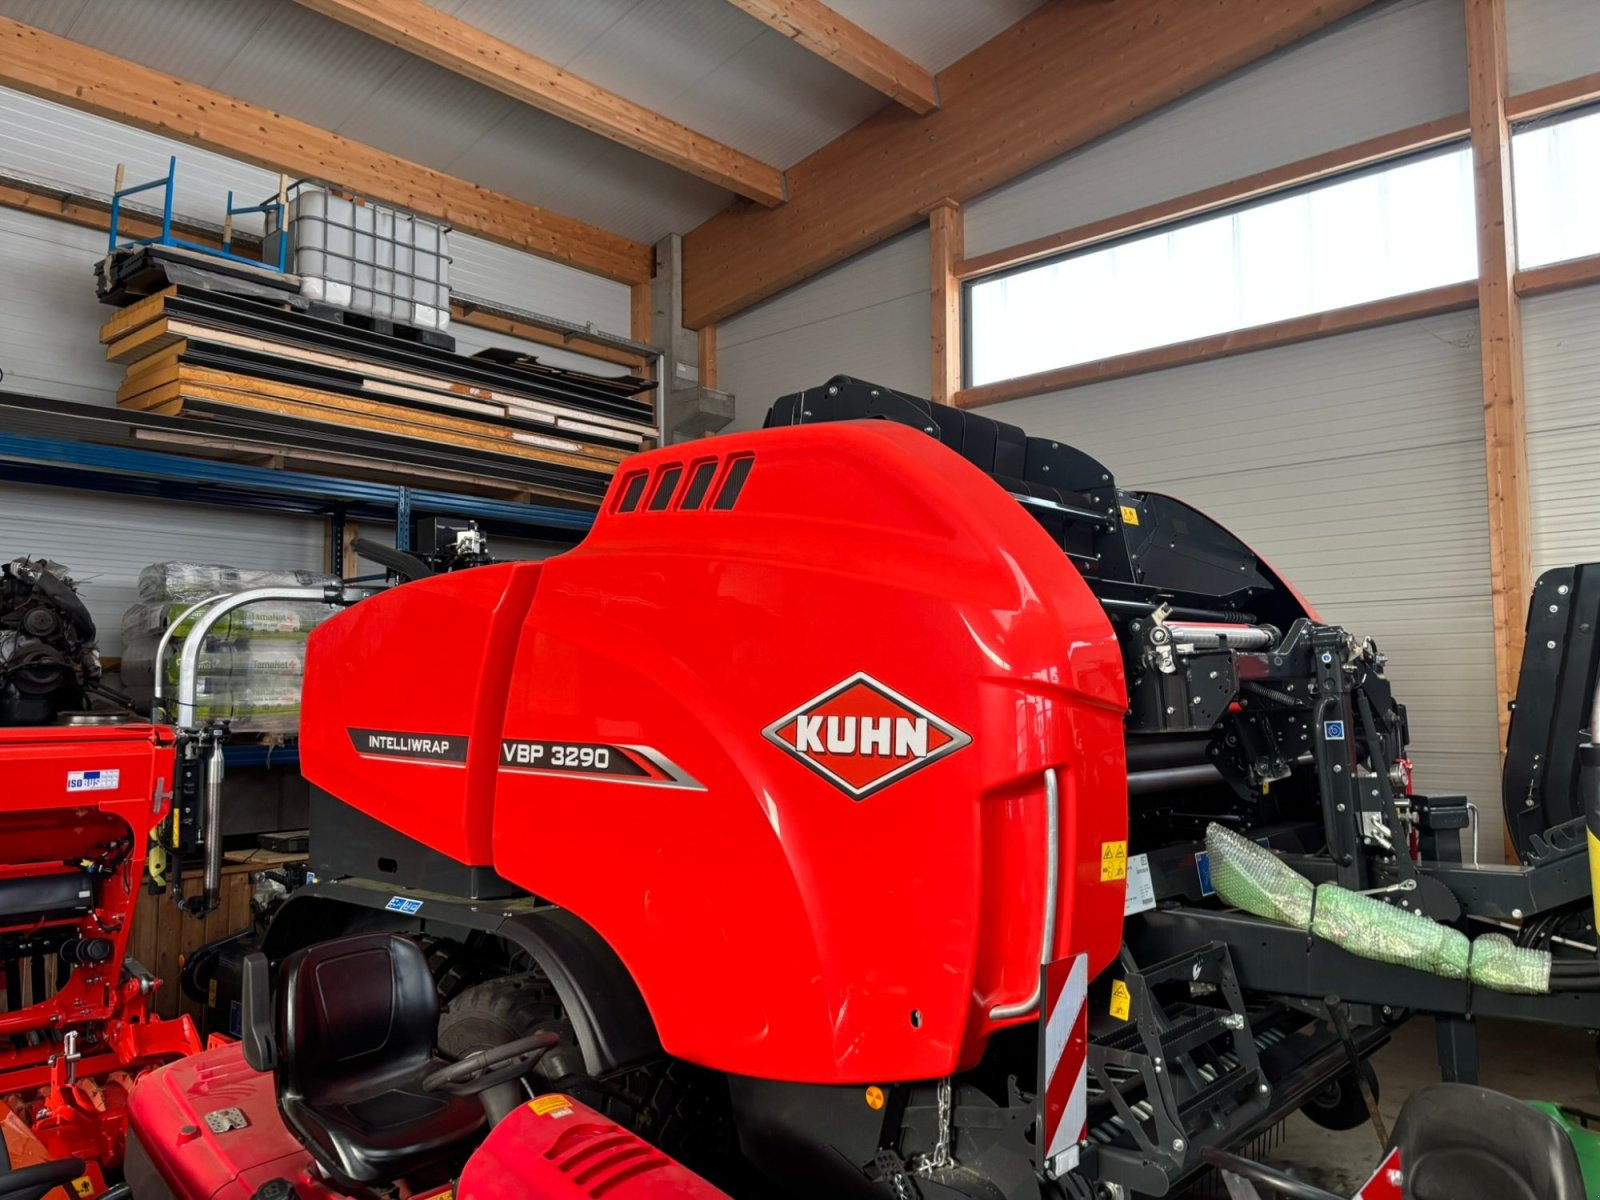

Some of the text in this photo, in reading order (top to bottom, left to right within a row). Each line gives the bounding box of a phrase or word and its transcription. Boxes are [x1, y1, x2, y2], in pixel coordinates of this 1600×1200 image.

[253, 660, 288, 669] TamaNet
[368, 734, 450, 754] INTELLIWRAP
[796, 714, 928, 757] KUHN
[503, 743, 609, 769] VBP 3290
